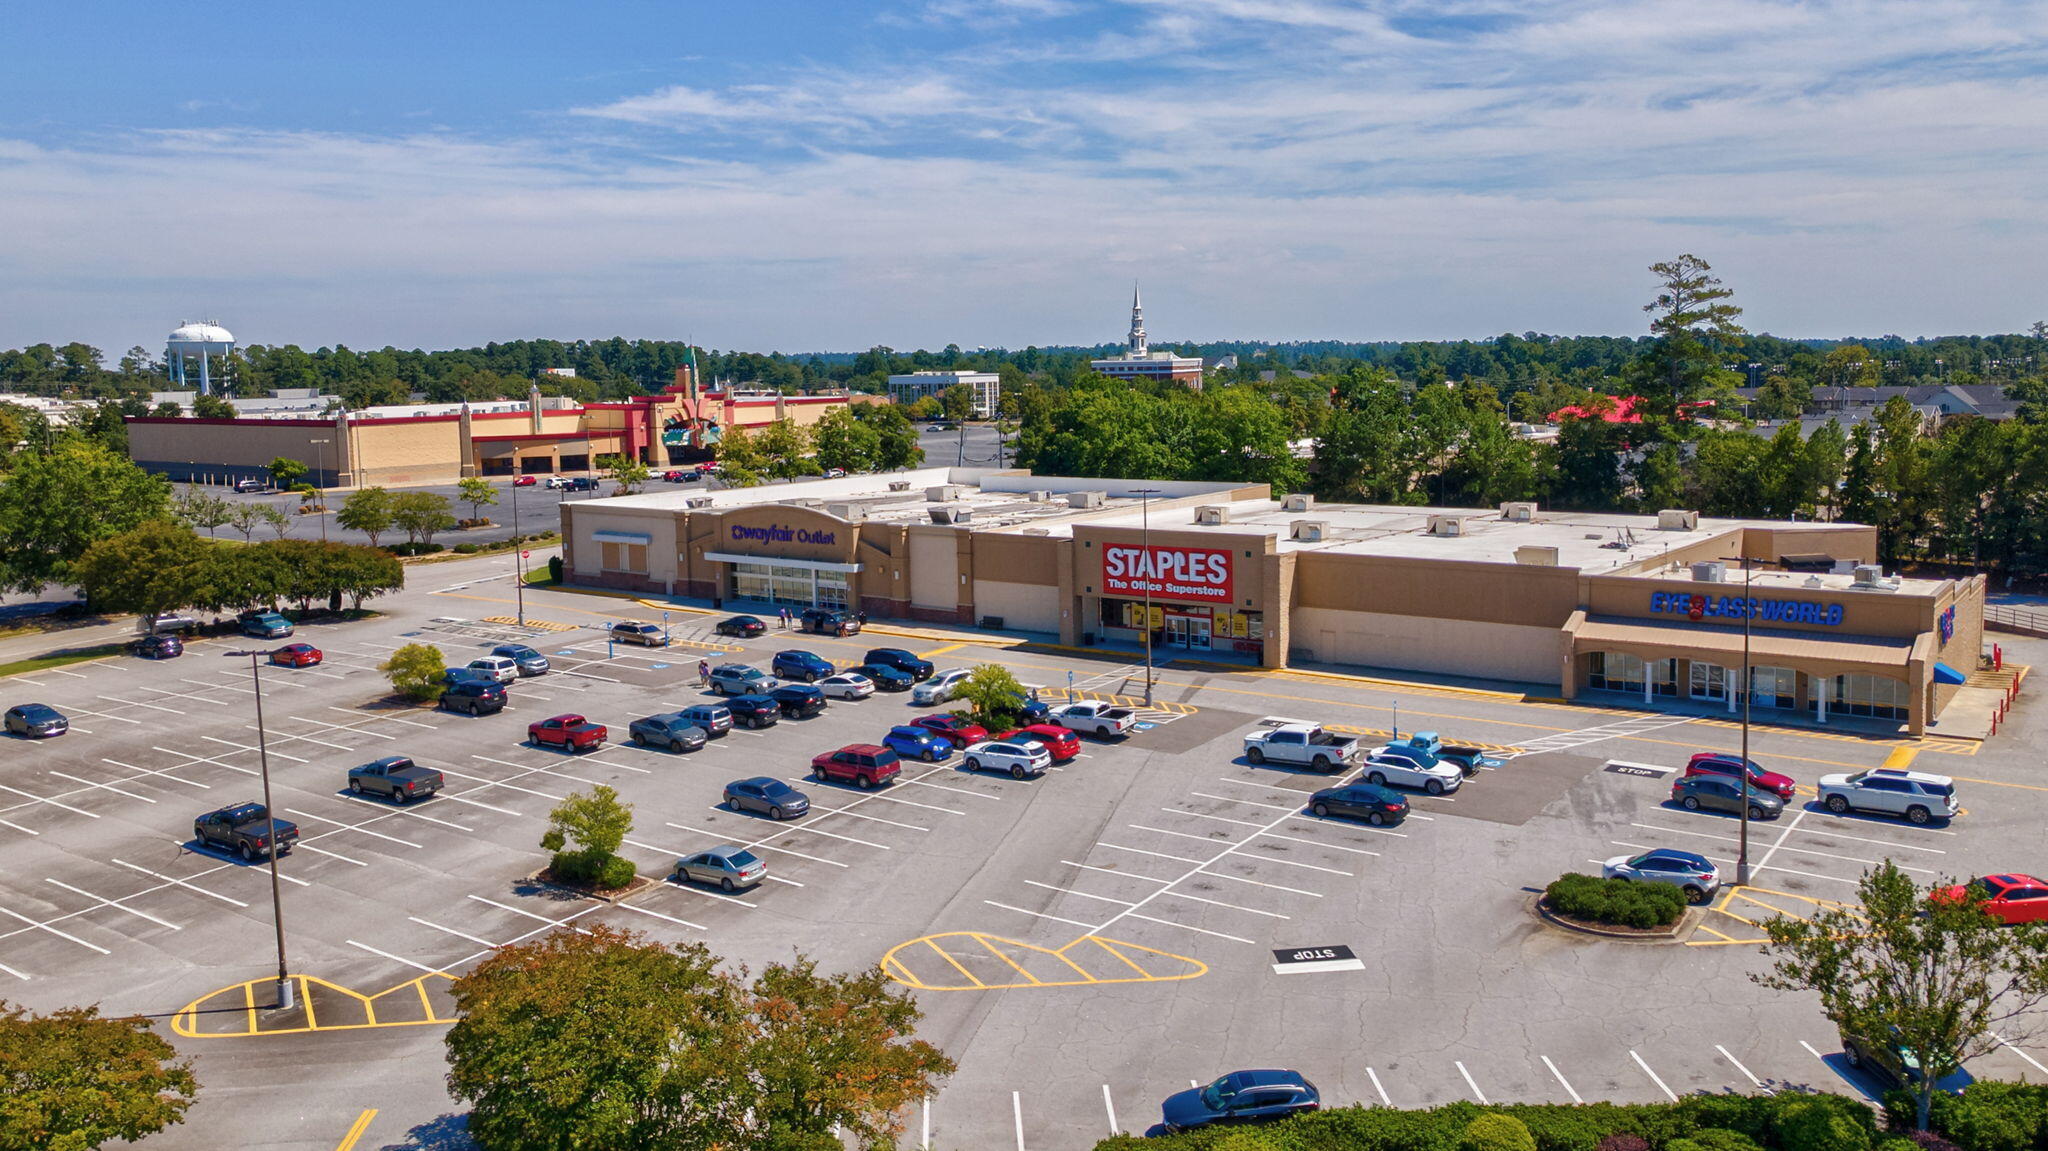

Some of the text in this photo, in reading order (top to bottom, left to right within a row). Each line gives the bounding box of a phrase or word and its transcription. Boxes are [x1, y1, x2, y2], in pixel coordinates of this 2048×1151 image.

[743, 523, 836, 545] wayfair Outlet
[1106, 547, 1228, 584] STAPLES
[1108, 578, 1128, 589] The
[1166, 583, 1226, 596] Superstore
[1761, 600, 1844, 626] WORLD
[1617, 766, 1653, 776] STOP
[1293, 949, 1336, 960] STOP
